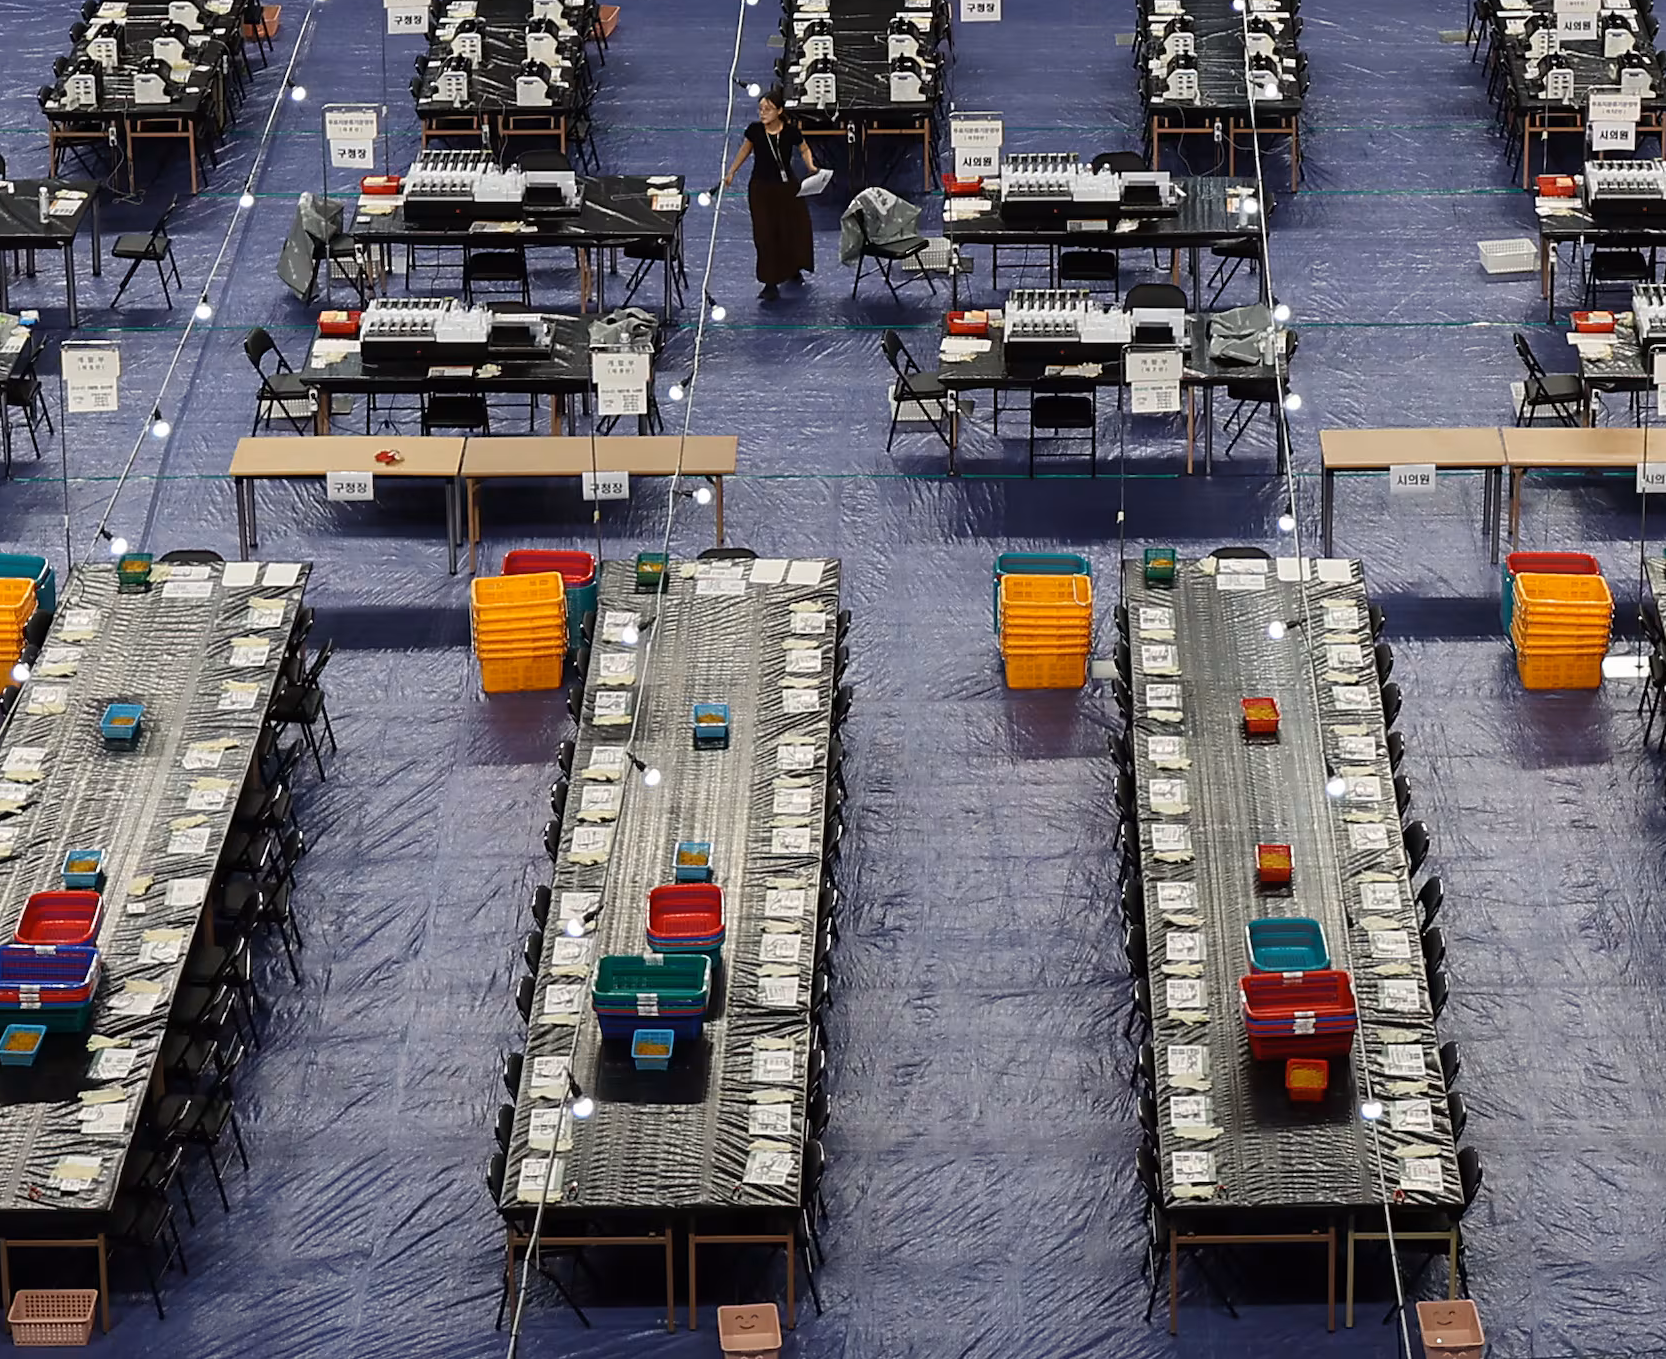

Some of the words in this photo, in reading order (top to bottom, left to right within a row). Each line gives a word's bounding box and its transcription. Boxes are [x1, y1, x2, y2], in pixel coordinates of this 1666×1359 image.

[967, 3, 994, 13] 구청장
[394, 15, 422, 25] 구청장
[1564, 21, 1591, 31] 시의원
[1599, 130, 1628, 140] 시의원
[337, 148, 366, 159] 구청장
[963, 156, 993, 167] 시의원
[1397, 473, 1430, 485] 시의원
[334, 482, 367, 494] 구청장
[589, 482, 622, 494] 구청장
